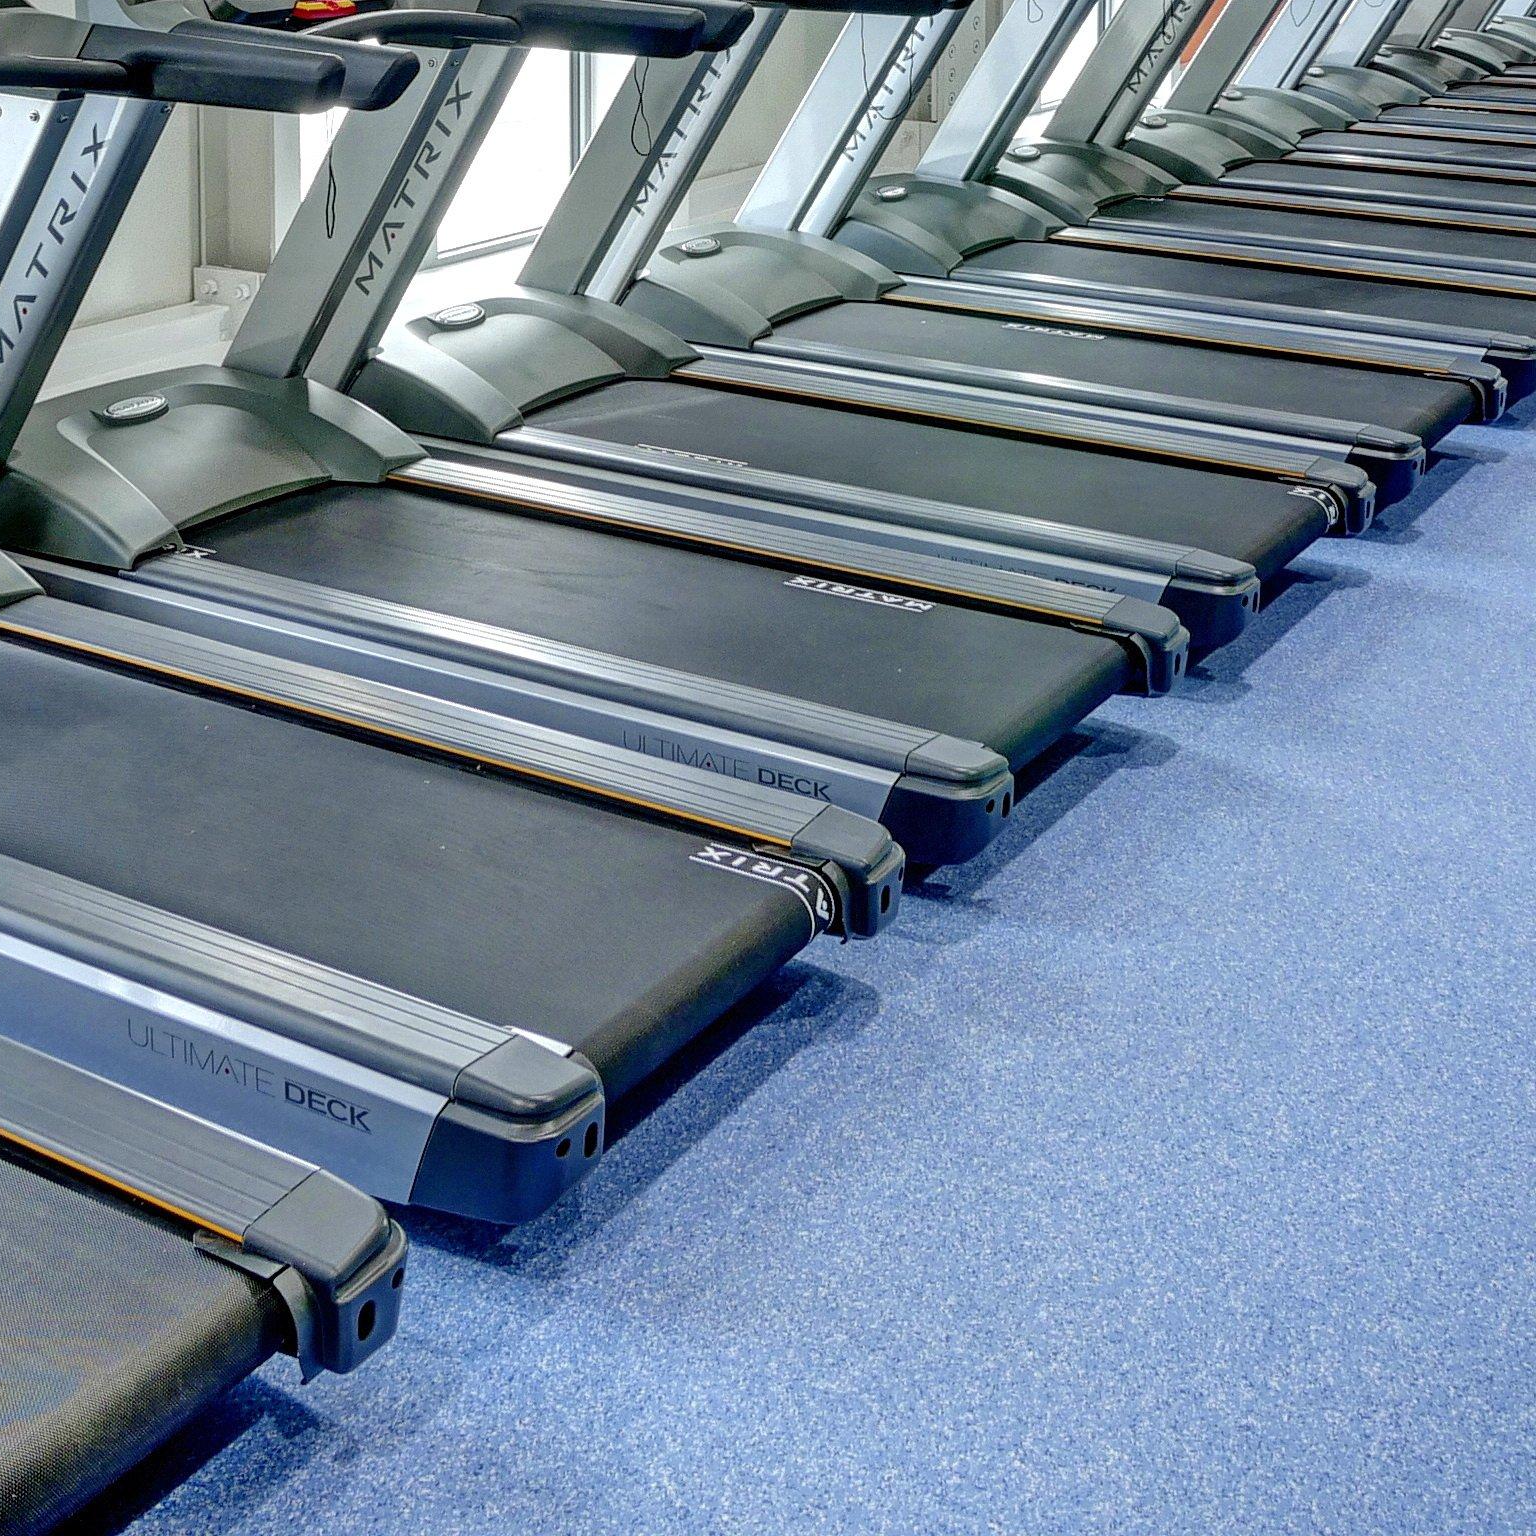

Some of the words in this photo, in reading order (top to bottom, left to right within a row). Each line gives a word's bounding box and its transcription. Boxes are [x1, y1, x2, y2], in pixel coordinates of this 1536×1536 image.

[842, 15, 934, 162] MATRI
[354, 76, 474, 297] MATRIX
[788, 575, 935, 612] MATRIX
[621, 728, 753, 784] ULTIMATE
[757, 767, 833, 802] DECK
[696, 845, 831, 921] ATRIX
[127, 1017, 277, 1099] ULTIMATE
[283, 1079, 373, 1135] DECK
